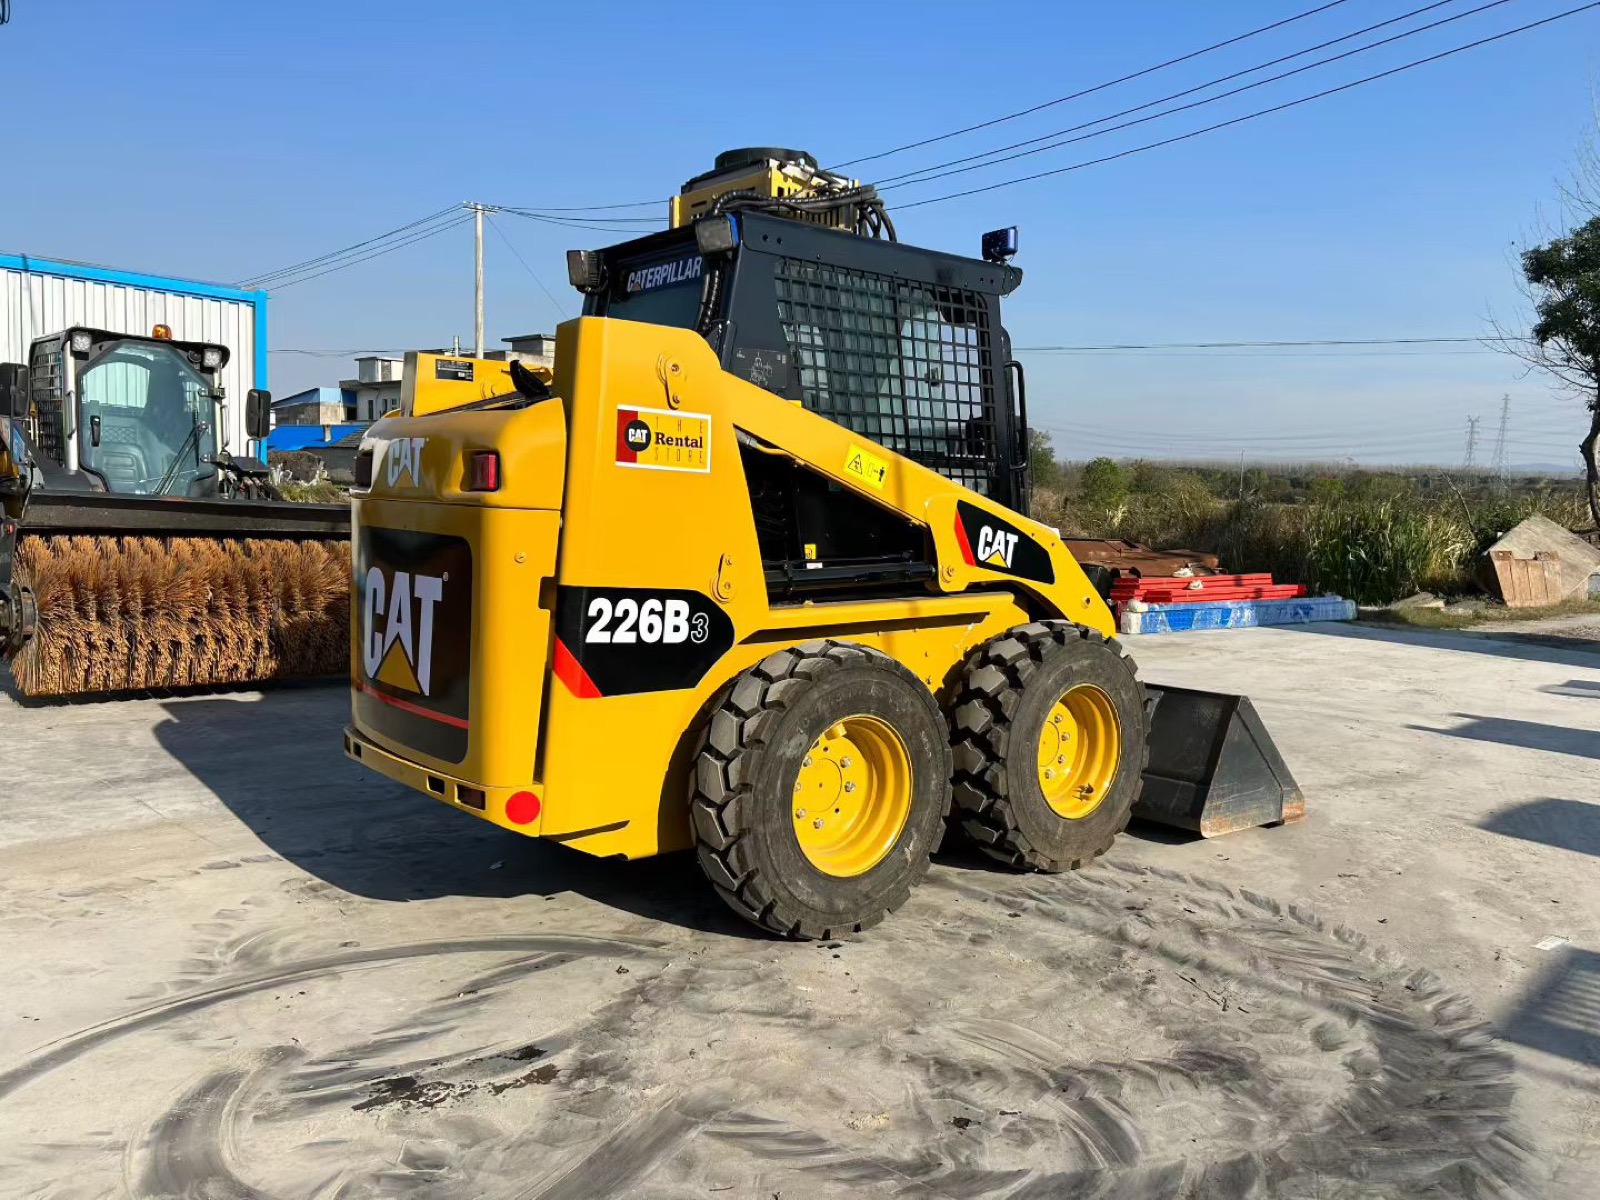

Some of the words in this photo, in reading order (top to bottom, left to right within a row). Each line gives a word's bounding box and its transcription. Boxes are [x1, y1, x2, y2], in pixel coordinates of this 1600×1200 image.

[626, 256, 702, 293] CATERPILLAR
[628, 428, 648, 443] CAT
[655, 431, 703, 448] Rental
[387, 437, 425, 488] CAT
[977, 525, 1019, 569] CAT
[364, 566, 443, 697] CAT
